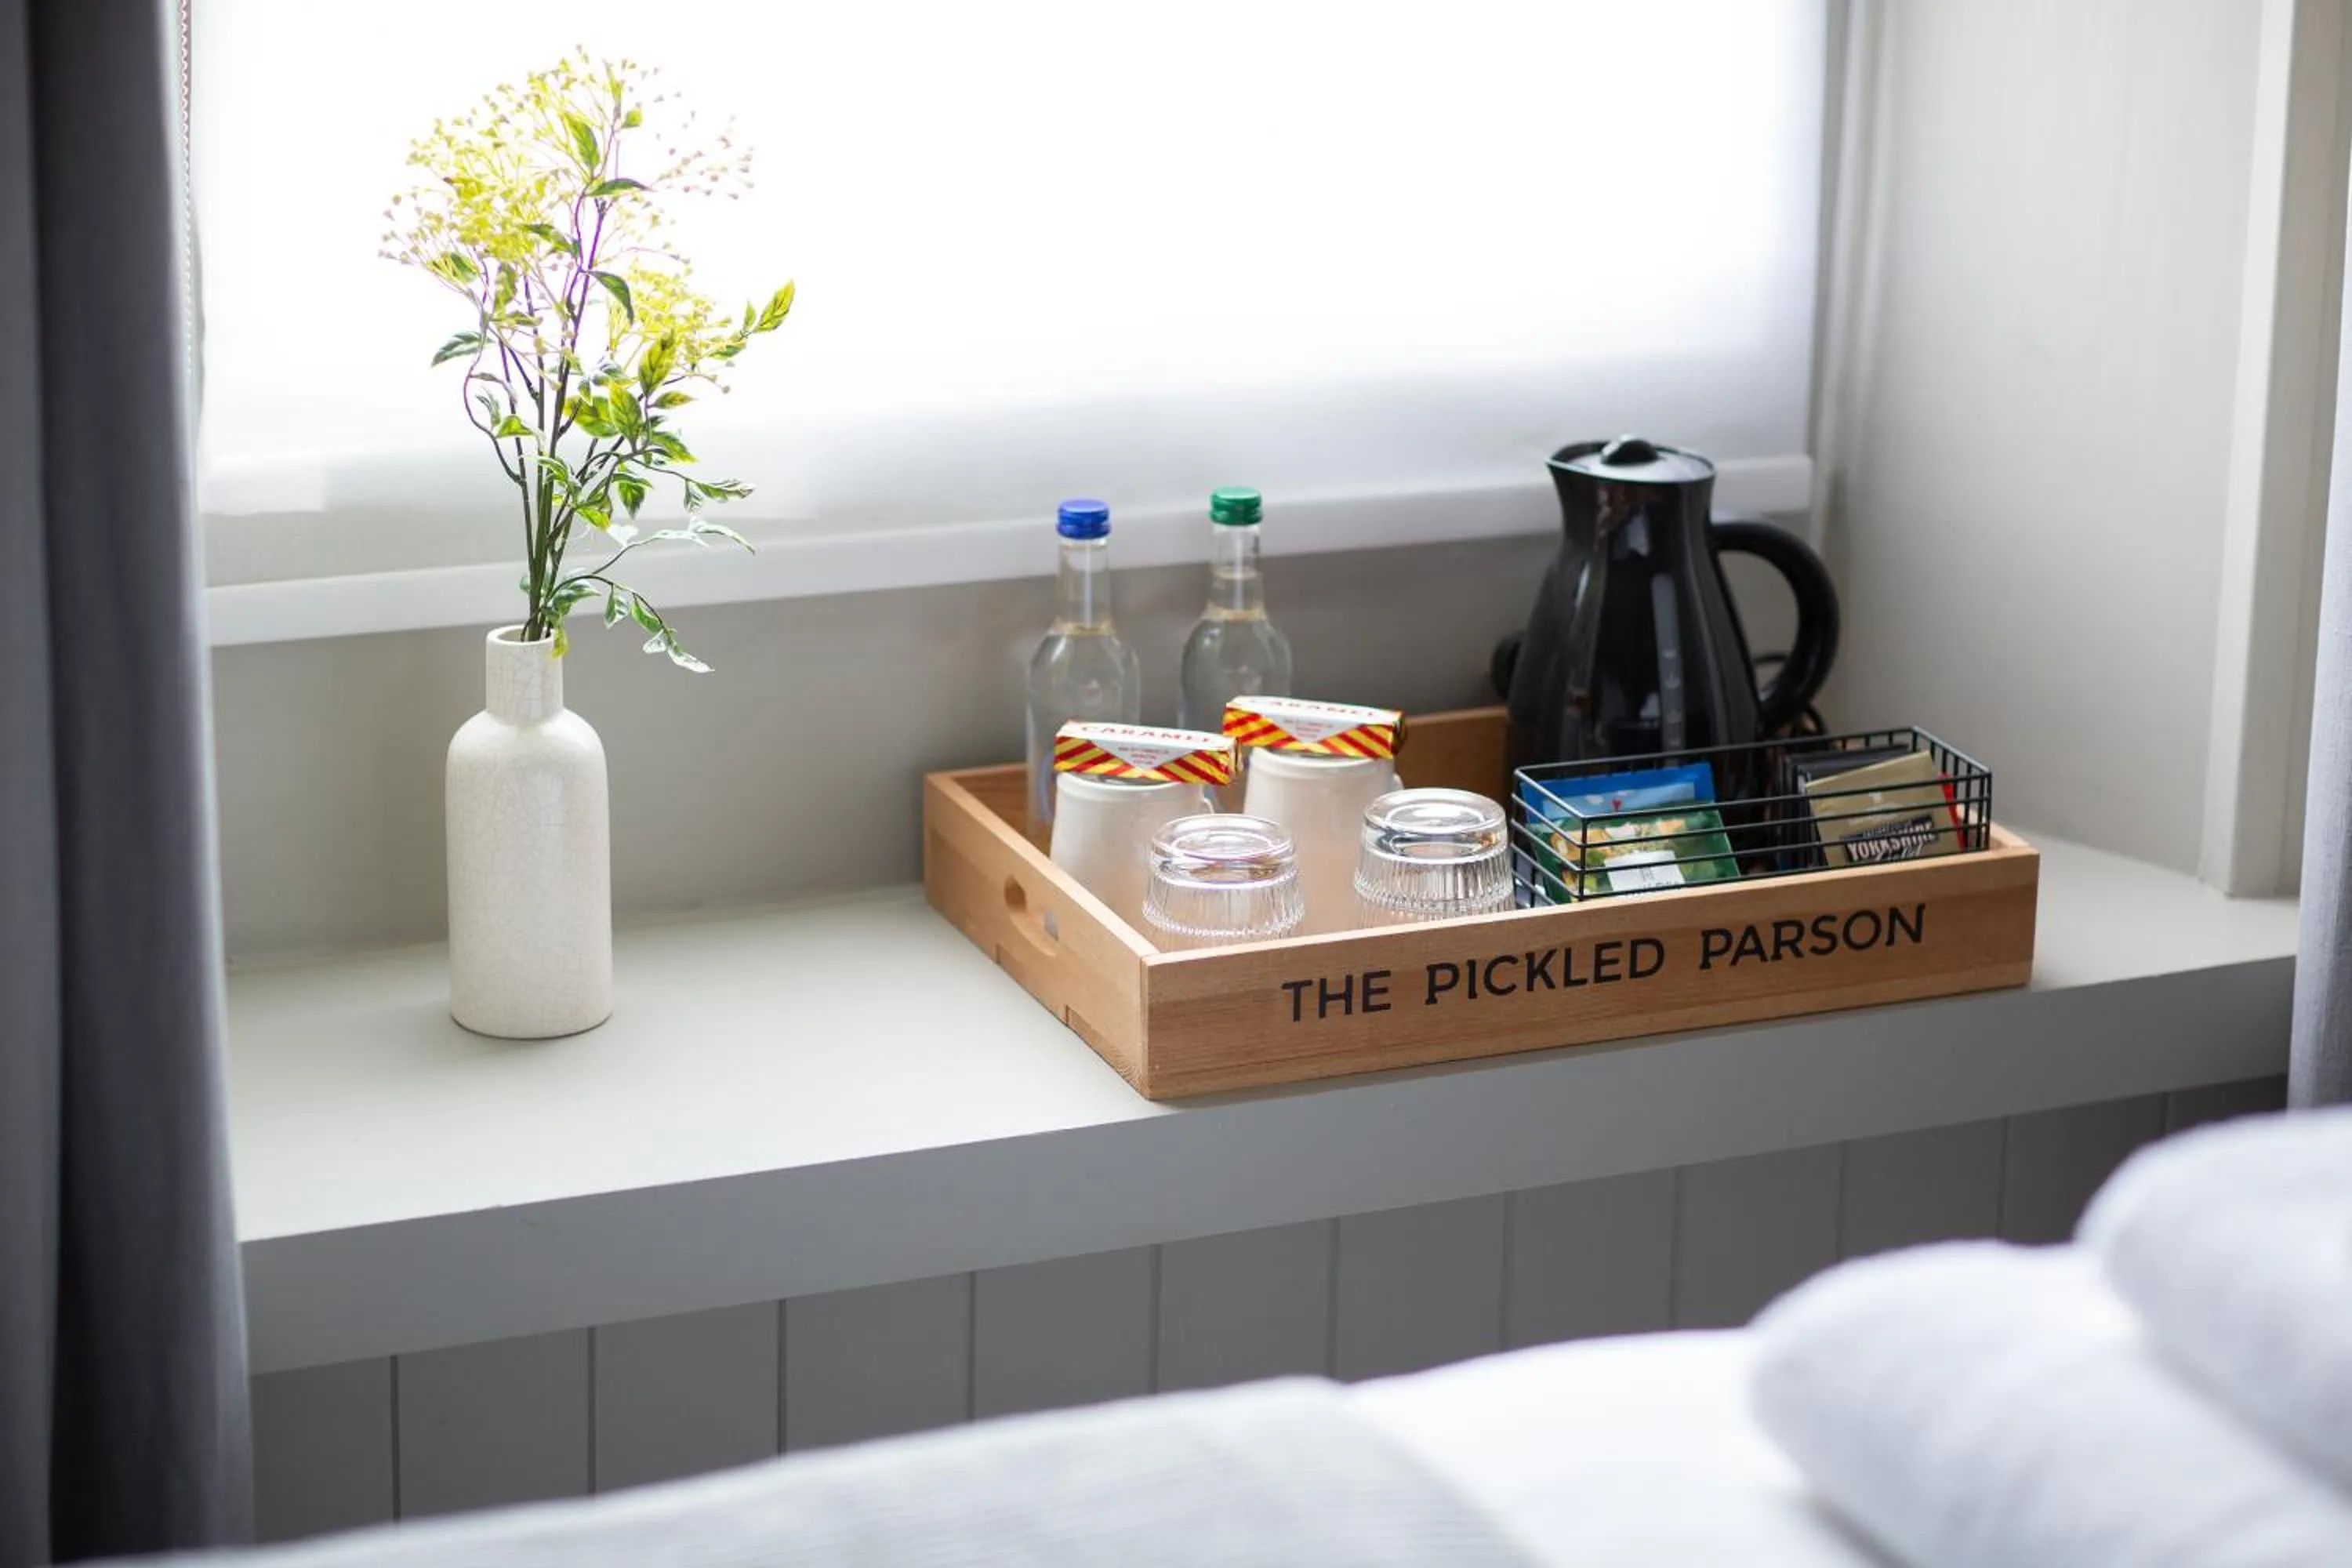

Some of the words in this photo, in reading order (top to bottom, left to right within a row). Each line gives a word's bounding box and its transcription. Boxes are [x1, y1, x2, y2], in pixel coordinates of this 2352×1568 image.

[1281, 970, 1392, 1023] THE
[1424, 937, 1666, 1006] PICKLED
[1699, 902, 1927, 971] PARSON
